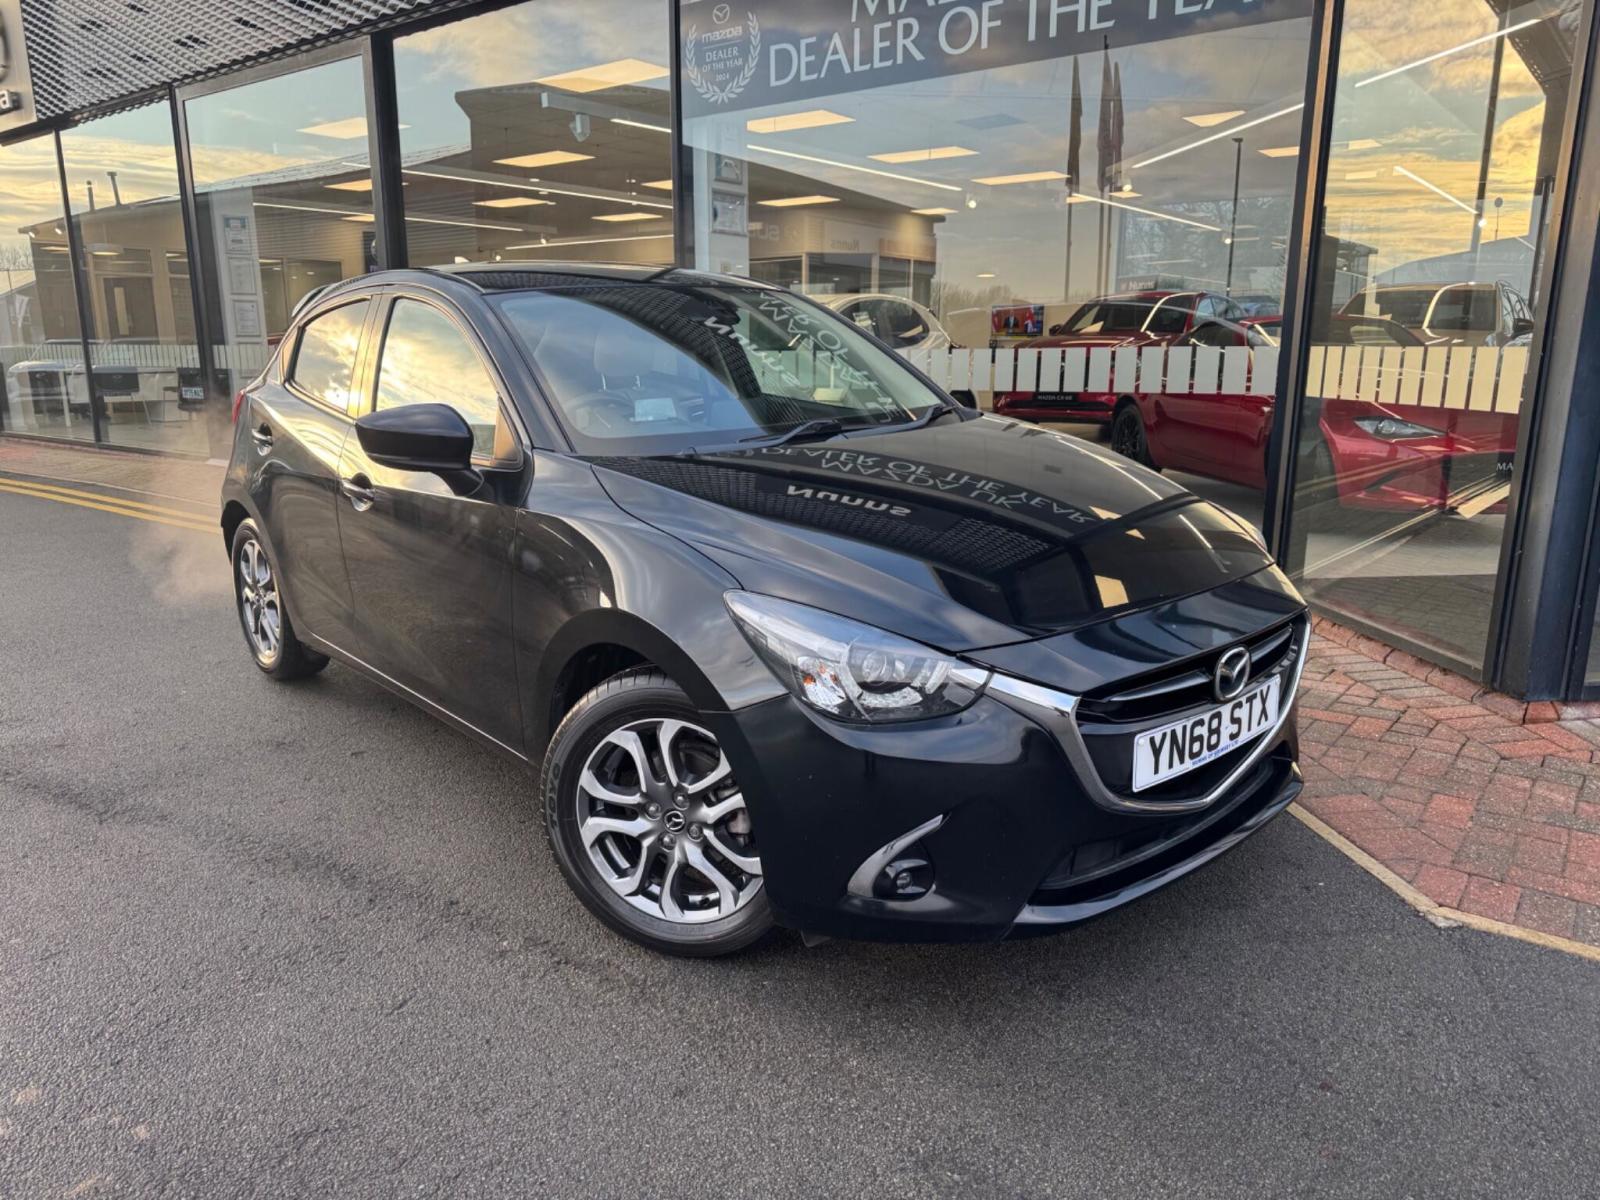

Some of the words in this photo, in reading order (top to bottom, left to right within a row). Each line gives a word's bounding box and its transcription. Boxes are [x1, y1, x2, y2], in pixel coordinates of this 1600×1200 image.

[702, 25, 742, 43] mazda
[769, 17, 925, 88] DEALER
[938, 0, 1002, 56] OF
[705, 46, 739, 62] DEALER
[702, 63, 711, 73] OF
[712, 61, 724, 70] THE
[726, 57, 743, 68] YEAR
[1150, 711, 1223, 776] YN68
[1229, 685, 1271, 741] STX
